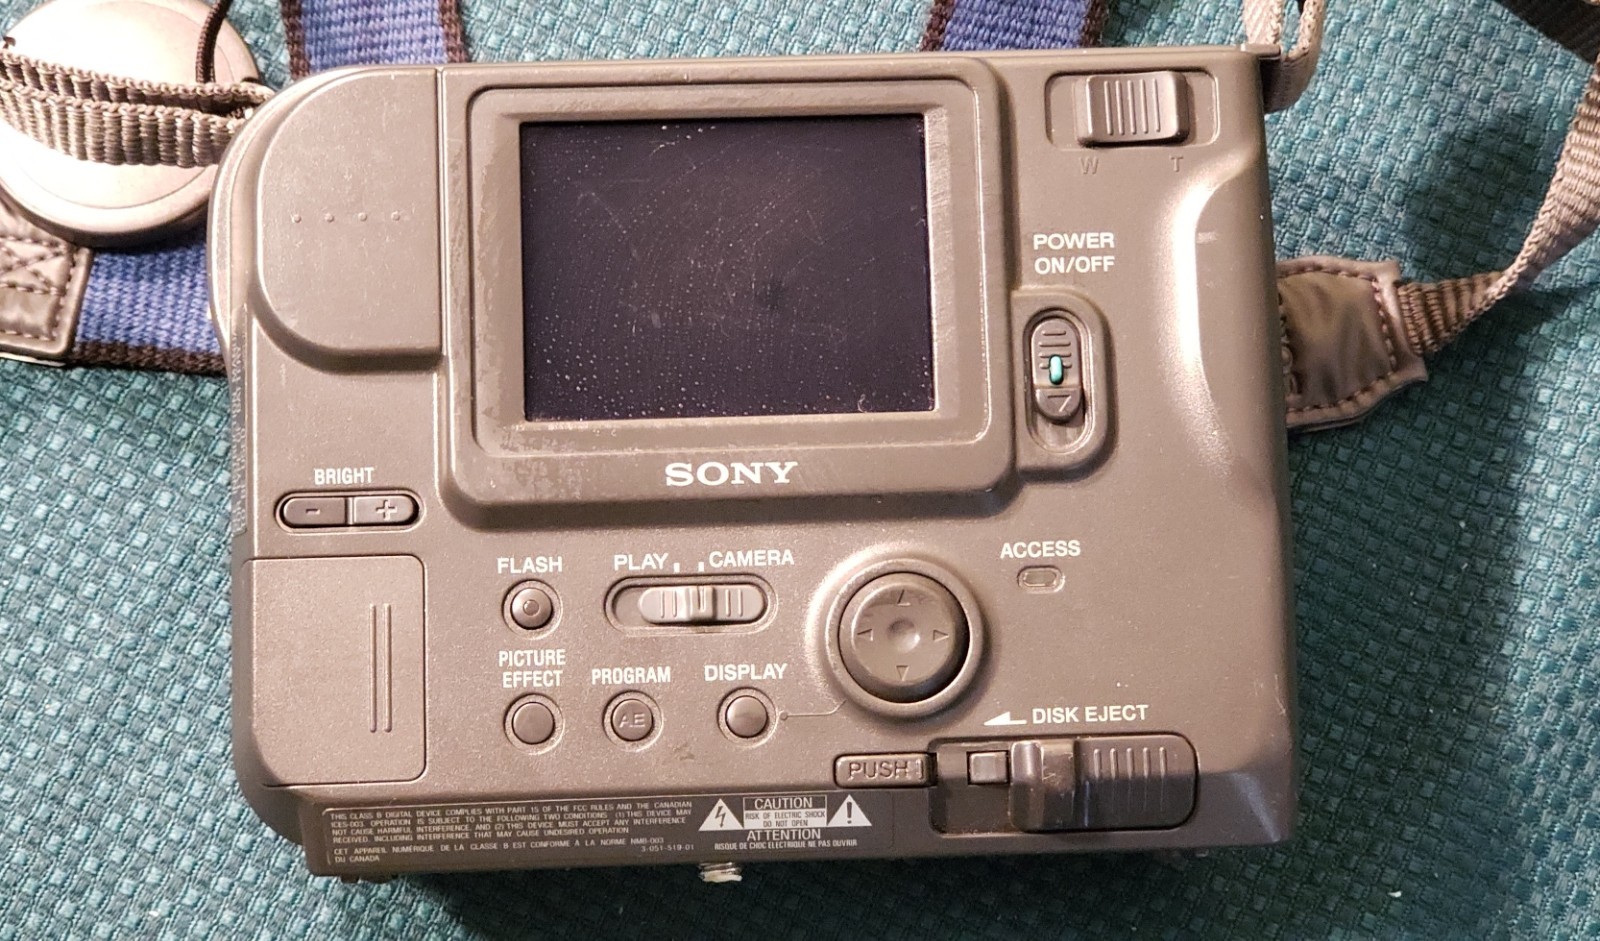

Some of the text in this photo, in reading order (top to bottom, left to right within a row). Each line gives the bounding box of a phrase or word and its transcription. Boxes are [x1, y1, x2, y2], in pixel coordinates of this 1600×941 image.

[1170, 155, 1184, 172] T
[1034, 233, 1114, 249] POWER
[1035, 256, 1115, 274] ON/OFF
[314, 467, 374, 485] BRIGHT
[666, 462, 798, 486] SONY
[1000, 540, 1080, 558] ACCESS
[498, 556, 562, 573] FLASH
[614, 553, 668, 570] PLAY
[709, 550, 794, 567] CAMERA
[499, 649, 565, 666] PICTURE
[503, 670, 563, 688] EFFECT
[592, 667, 670, 684] PROGRAM
[705, 663, 787, 681] DISPLAY
[619, 712, 645, 728] AE
[1033, 705, 1148, 723] DISK EJECT
[848, 760, 909, 780] PUSH
[445, 808, 482, 816] COMPLIES
[485, 807, 505, 815] WITH
[507, 806, 526, 814] PART
[754, 797, 813, 810] CAUTION
[370, 819, 411, 827] OPERATION
[428, 817, 460, 825] SUBJECT
[497, 814, 540, 822] FOLLOWING
[745, 812, 760, 820] RISK
[774, 811, 802, 819] ELECTRIC
[377, 826, 412, 834] HARMFUL
[527, 821, 554, 829] DEVICE
[633, 817, 686, 825] INTERFERENCE
[416, 832, 470, 840] INTERFERENCE
[544, 828, 585, 836] UNDESIRED
[747, 829, 821, 841] ATTENTION
[440, 844, 450, 852] DE
[530, 840, 570, 848] CONFORME
[600, 838, 626, 846] NORME
[714, 842, 738, 850] RISQUE
[749, 841, 767, 849] CHOC
[808, 840, 817, 848] NE
[832, 839, 857, 847] OUVRIR
